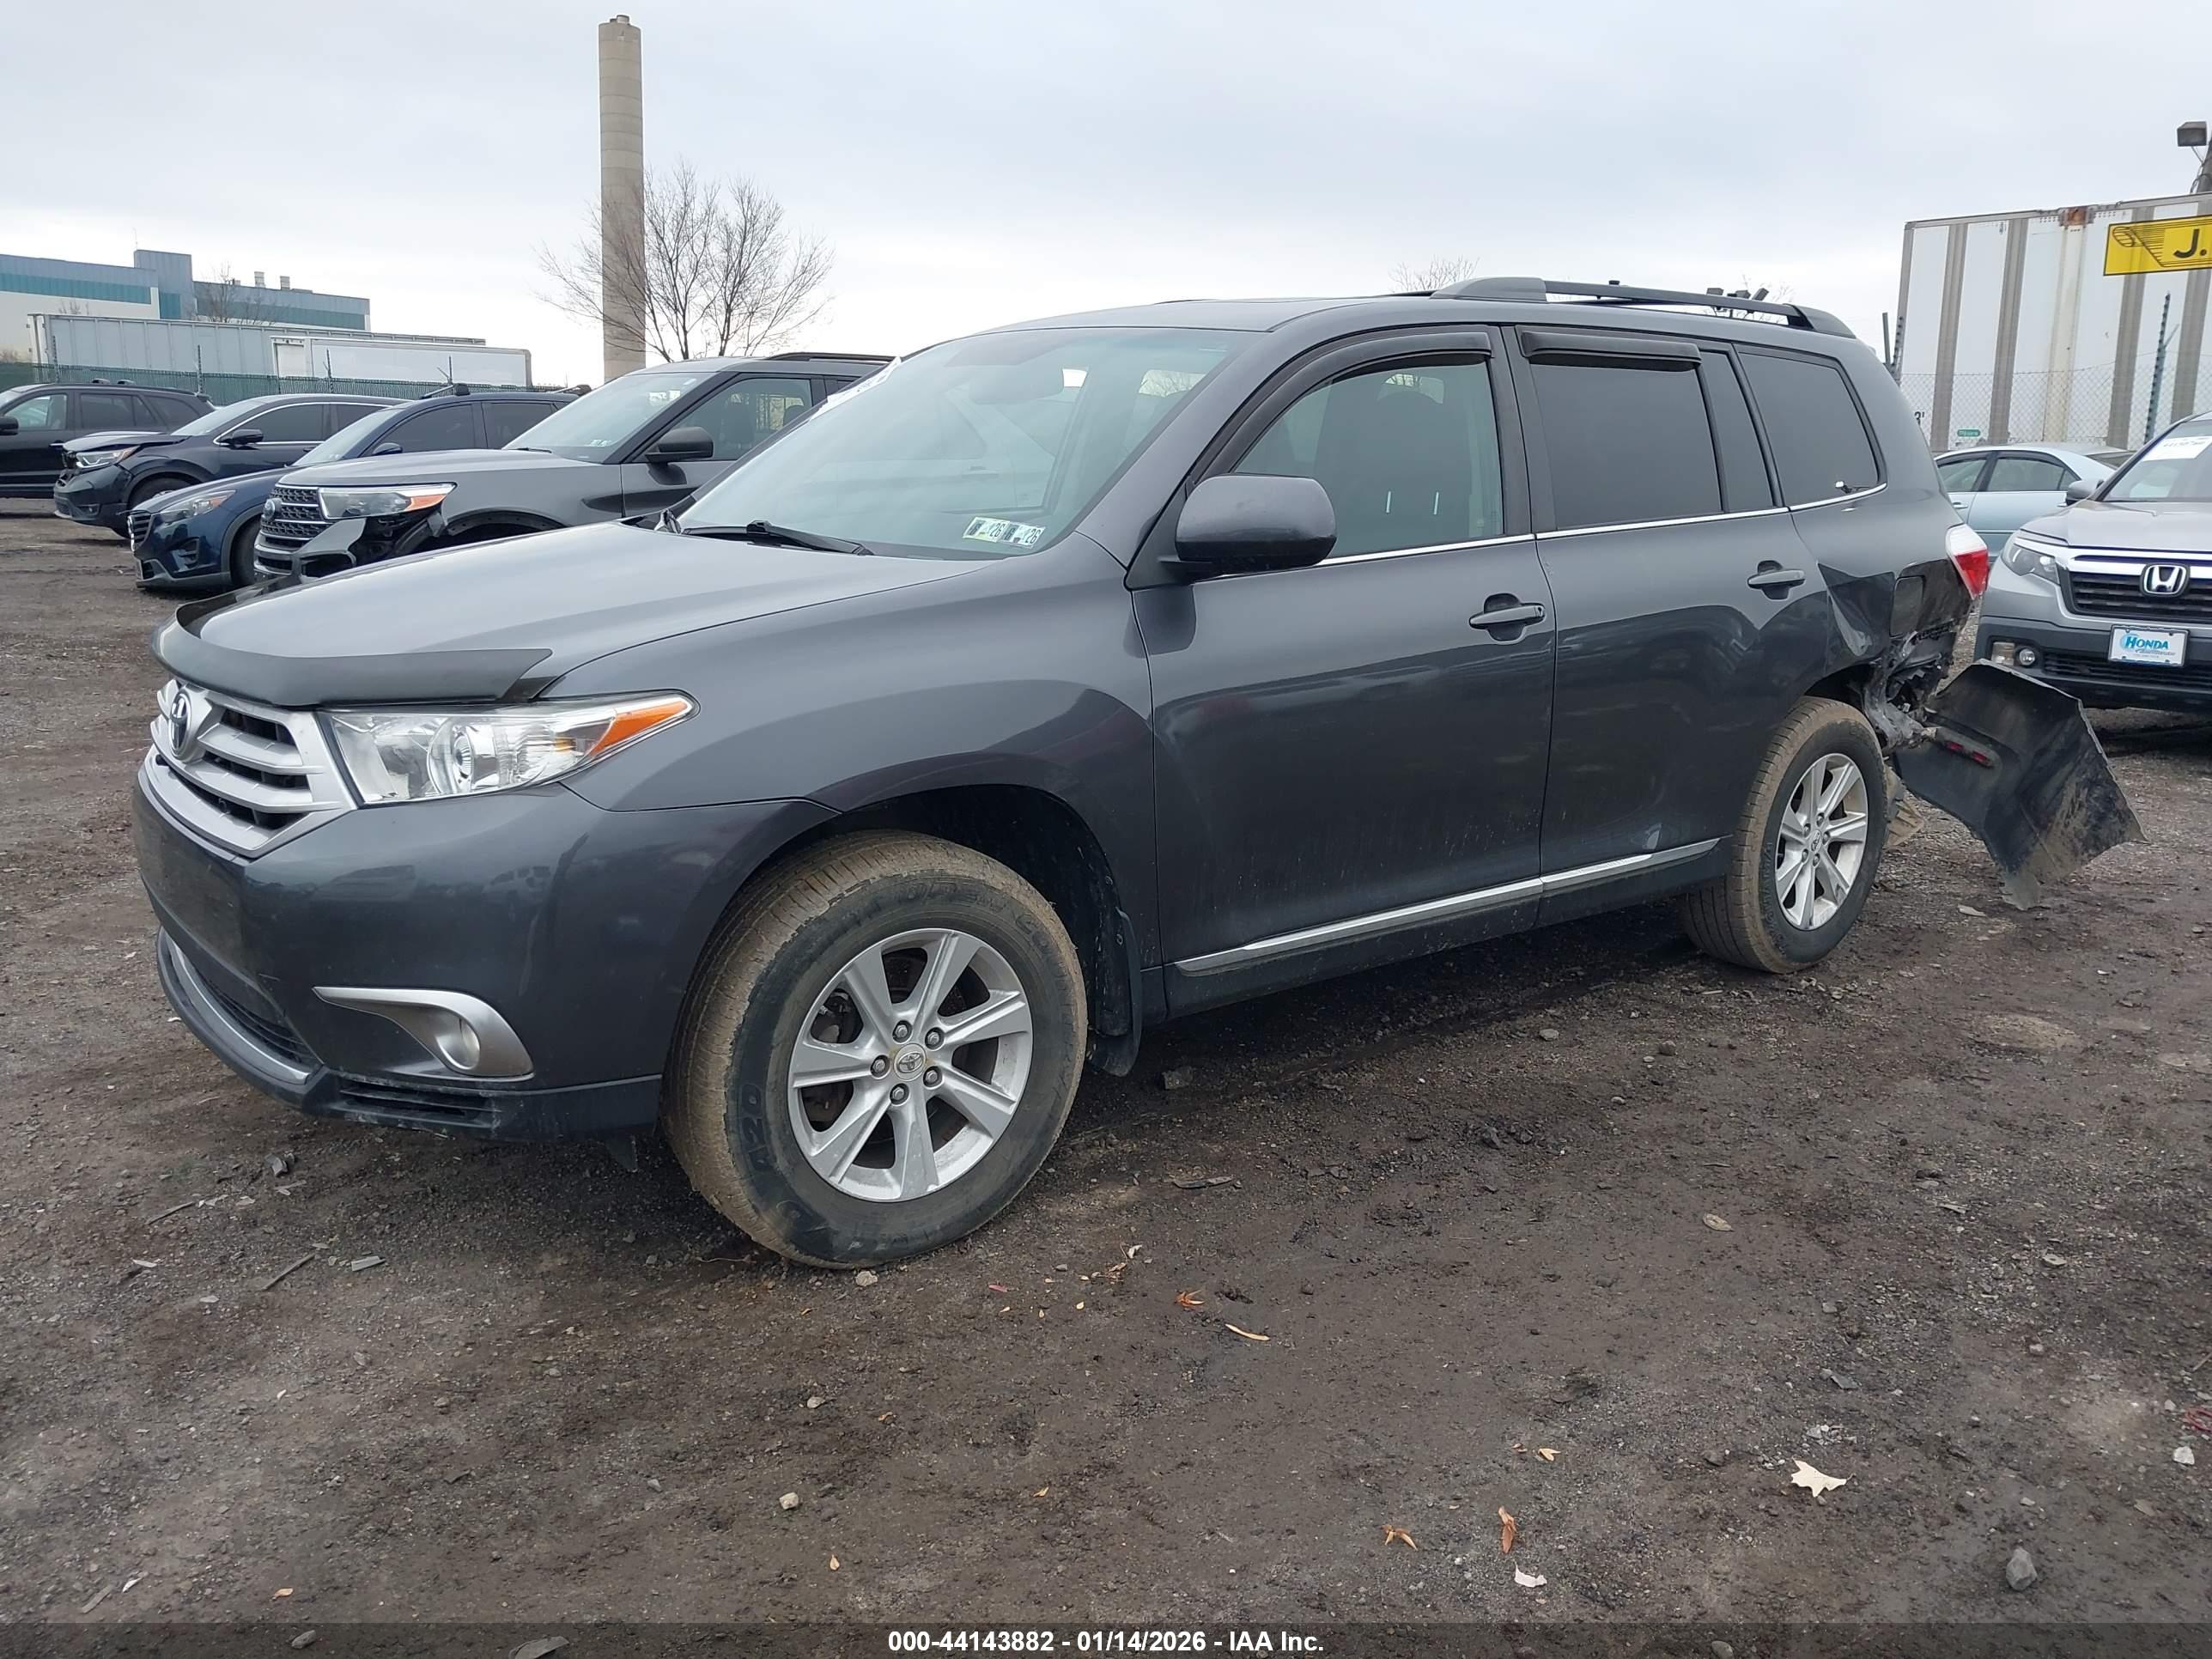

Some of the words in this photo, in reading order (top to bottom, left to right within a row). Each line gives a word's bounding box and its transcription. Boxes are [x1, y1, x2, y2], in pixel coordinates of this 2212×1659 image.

[989, 522, 1006, 538] 26
[1024, 528, 1042, 544] 26
[2125, 635, 2169, 650] HONDA
